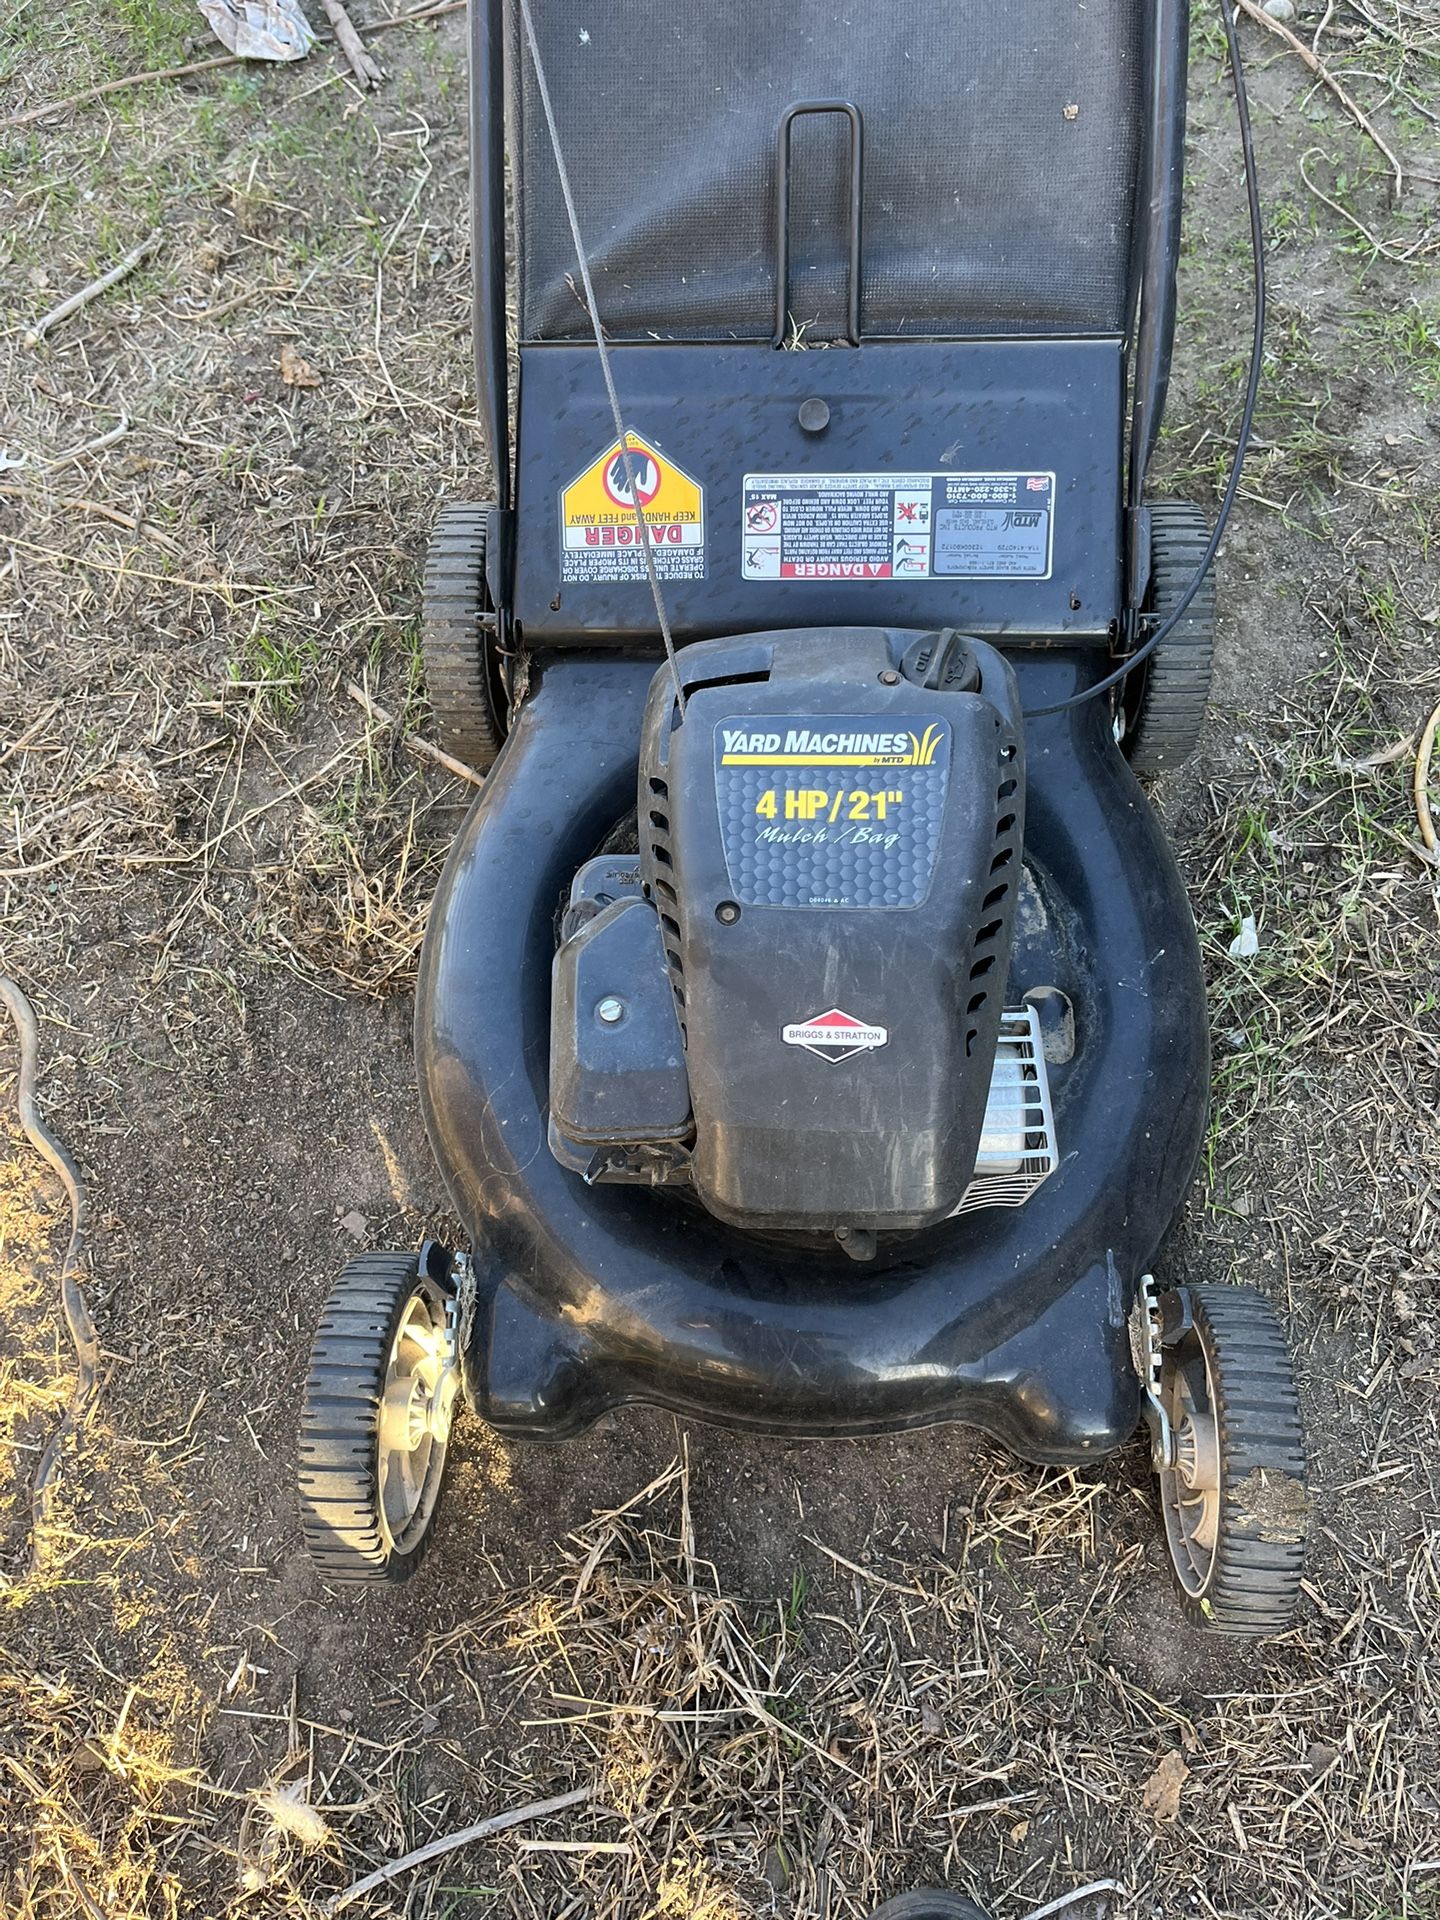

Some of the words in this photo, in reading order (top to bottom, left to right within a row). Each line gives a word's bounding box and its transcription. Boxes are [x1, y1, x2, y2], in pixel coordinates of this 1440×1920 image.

[570, 514, 596, 524] AWAY
[598, 514, 619, 523] FEET
[622, 513, 636, 522] and
[672, 511, 695, 521] KEEP
[1013, 517, 1040, 527] MTD
[794, 563, 864, 576] DANGER
[915, 648, 933, 672] OIL
[722, 730, 780, 753] YARD
[784, 730, 908, 753] MACHINES
[755, 790, 778, 820] 4
[755, 826, 829, 844] Mulch
[789, 1030, 824, 1039] BRIGGS
[825, 1031, 832, 1039] &
[834, 1032, 880, 1040] STRATTON
